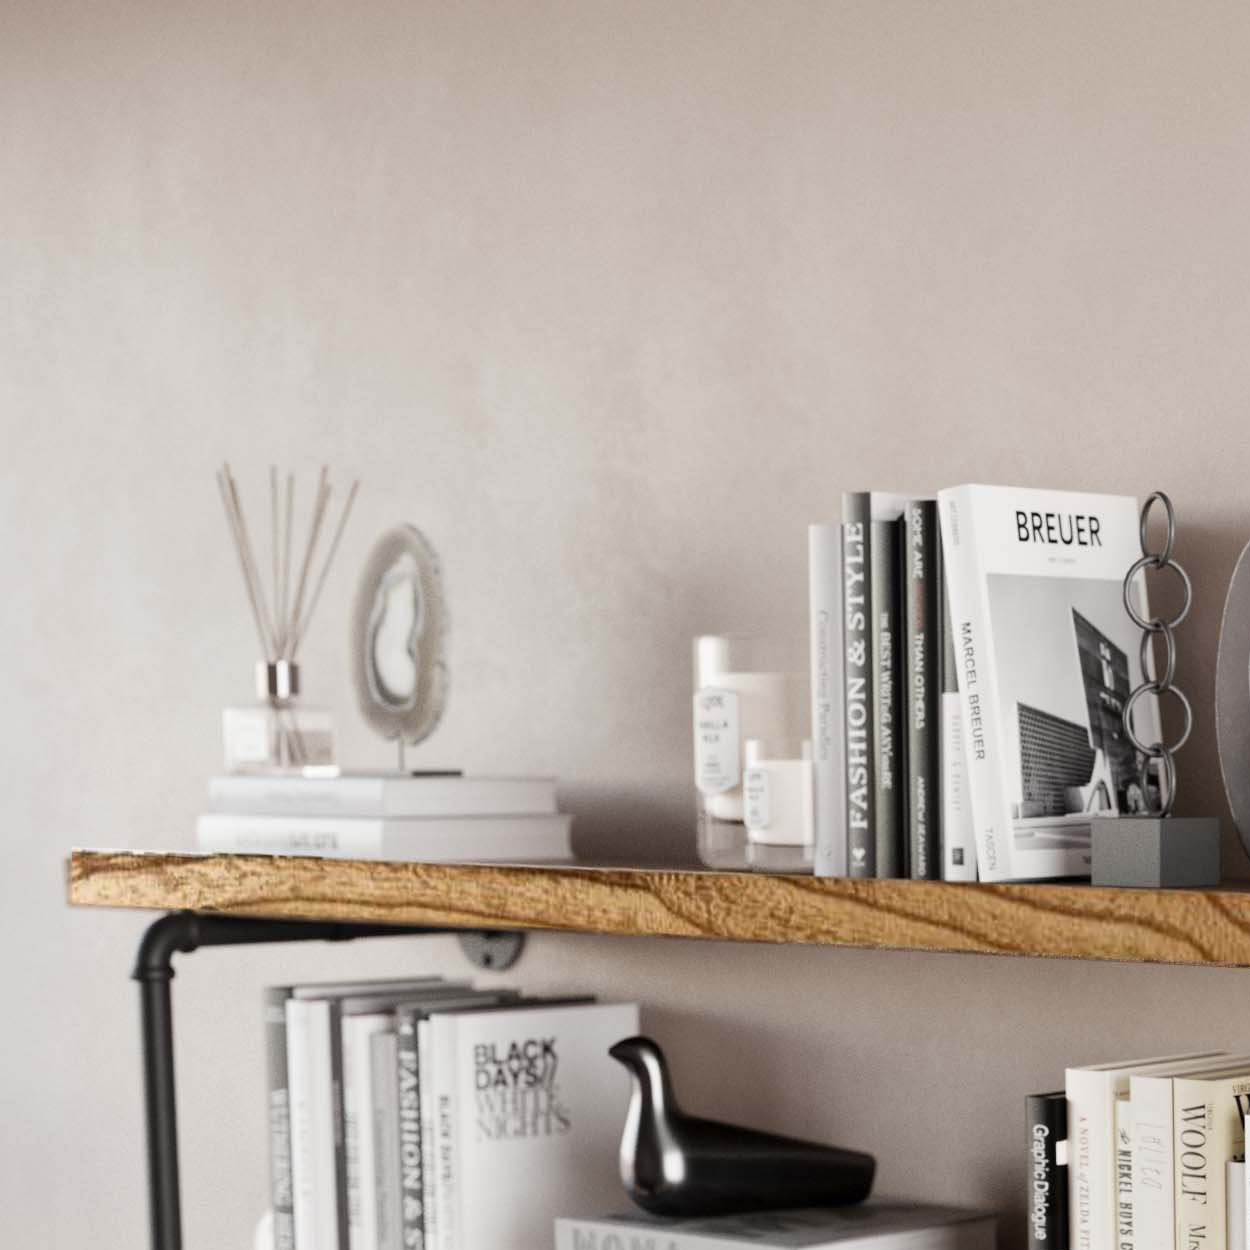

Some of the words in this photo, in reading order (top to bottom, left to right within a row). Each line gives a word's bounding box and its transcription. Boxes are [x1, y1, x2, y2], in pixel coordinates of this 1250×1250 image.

[1016, 509, 1102, 546] BREUER
[846, 522, 865, 631] STYLE
[847, 639, 866, 666] &
[914, 633, 925, 672] THAN
[961, 621, 978, 690] MARCEL
[968, 694, 986, 760] BREUER
[848, 677, 868, 829] FASHION
[474, 1037, 557, 1065] BLACK
[400, 1051, 420, 1190] FASHION
[1030, 1124, 1049, 1179] Graphic
[1080, 1128, 1090, 1169] NOVEL
[1119, 1149, 1133, 1194] NICKEL
[1181, 1104, 1207, 1205] WOOLF
[1031, 1180, 1050, 1241] Dialogue
[1080, 1186, 1091, 1225] ZELDA
[1119, 1202, 1134, 1237] BOYS
